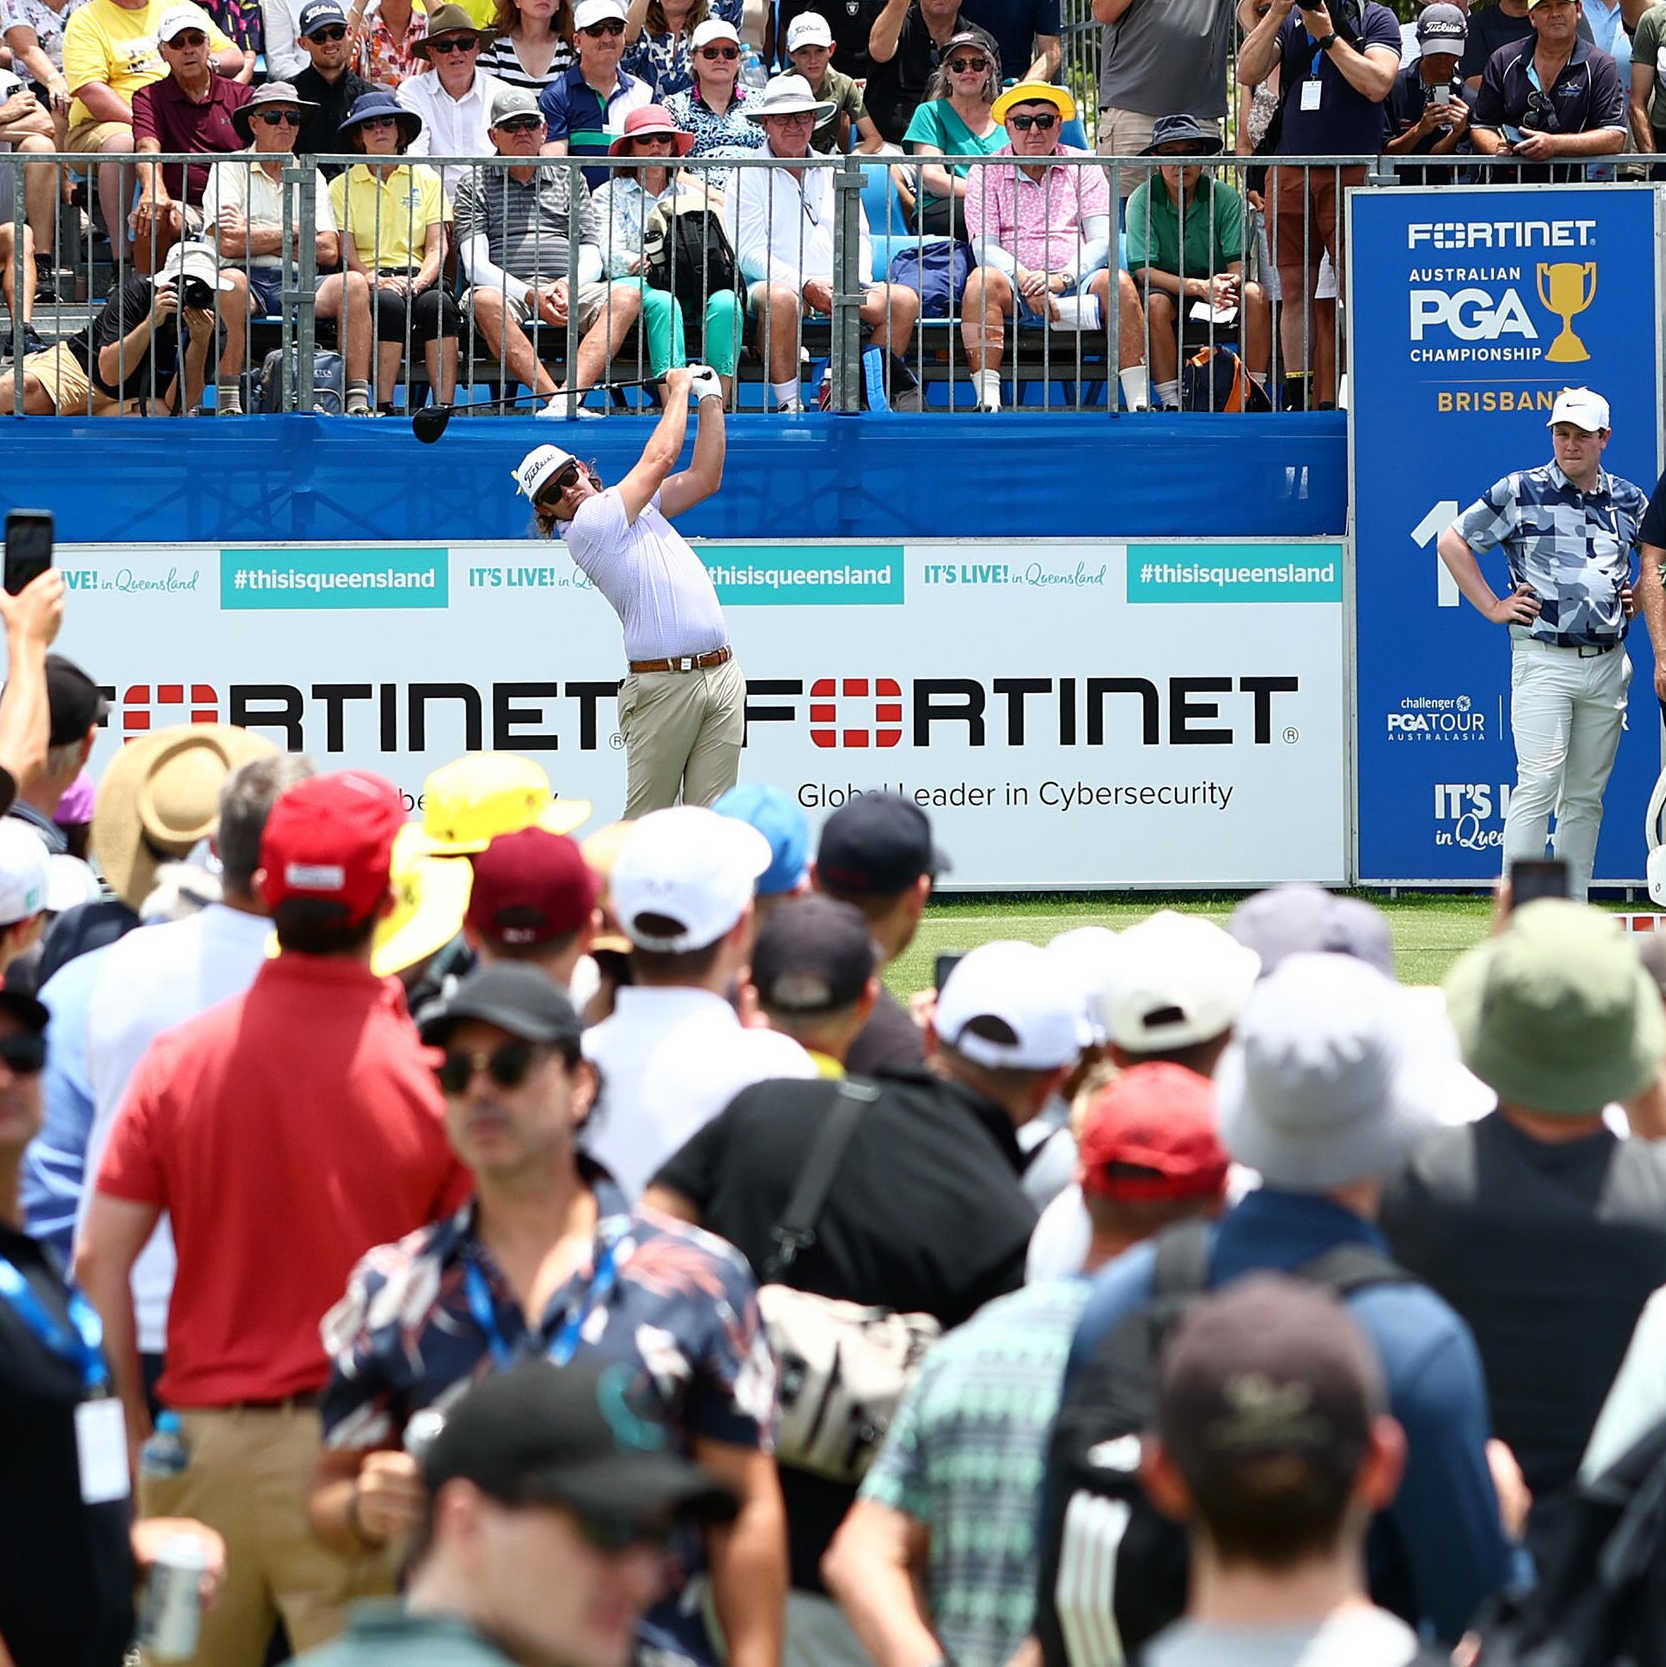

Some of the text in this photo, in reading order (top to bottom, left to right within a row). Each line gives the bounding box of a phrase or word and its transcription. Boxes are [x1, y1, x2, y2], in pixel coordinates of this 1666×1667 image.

[1424, 21, 1462, 34] Titleist
[1409, 266, 1521, 282] AUSTRALIAN
[1410, 288, 1539, 341] PGA
[1410, 347, 1542, 362] CHAMPIONSHIP
[1437, 390, 1569, 412] BRISBAN
[524, 452, 556, 489] Titleist
[101, 576, 114, 591] in
[114, 567, 200, 594] Queensland
[233, 567, 436, 595] #thisisqueensland
[469, 567, 503, 588] IT'S
[506, 567, 556, 587] LIVE!
[558, 574, 571, 587] in
[706, 563, 892, 590] thisisqueensland
[924, 561, 1109, 588] IT'S LIVE! in Queensland
[1139, 561, 1335, 588] #thisisqueensland
[1401, 694, 1455, 712] challenger
[1388, 734, 1485, 742] AUSTRALASIA
[1005, 783, 1030, 808] in
[1039, 781, 1235, 811] Cybersecurity
[1435, 783, 1493, 820] IT'S
[1436, 830, 1453, 846] in
